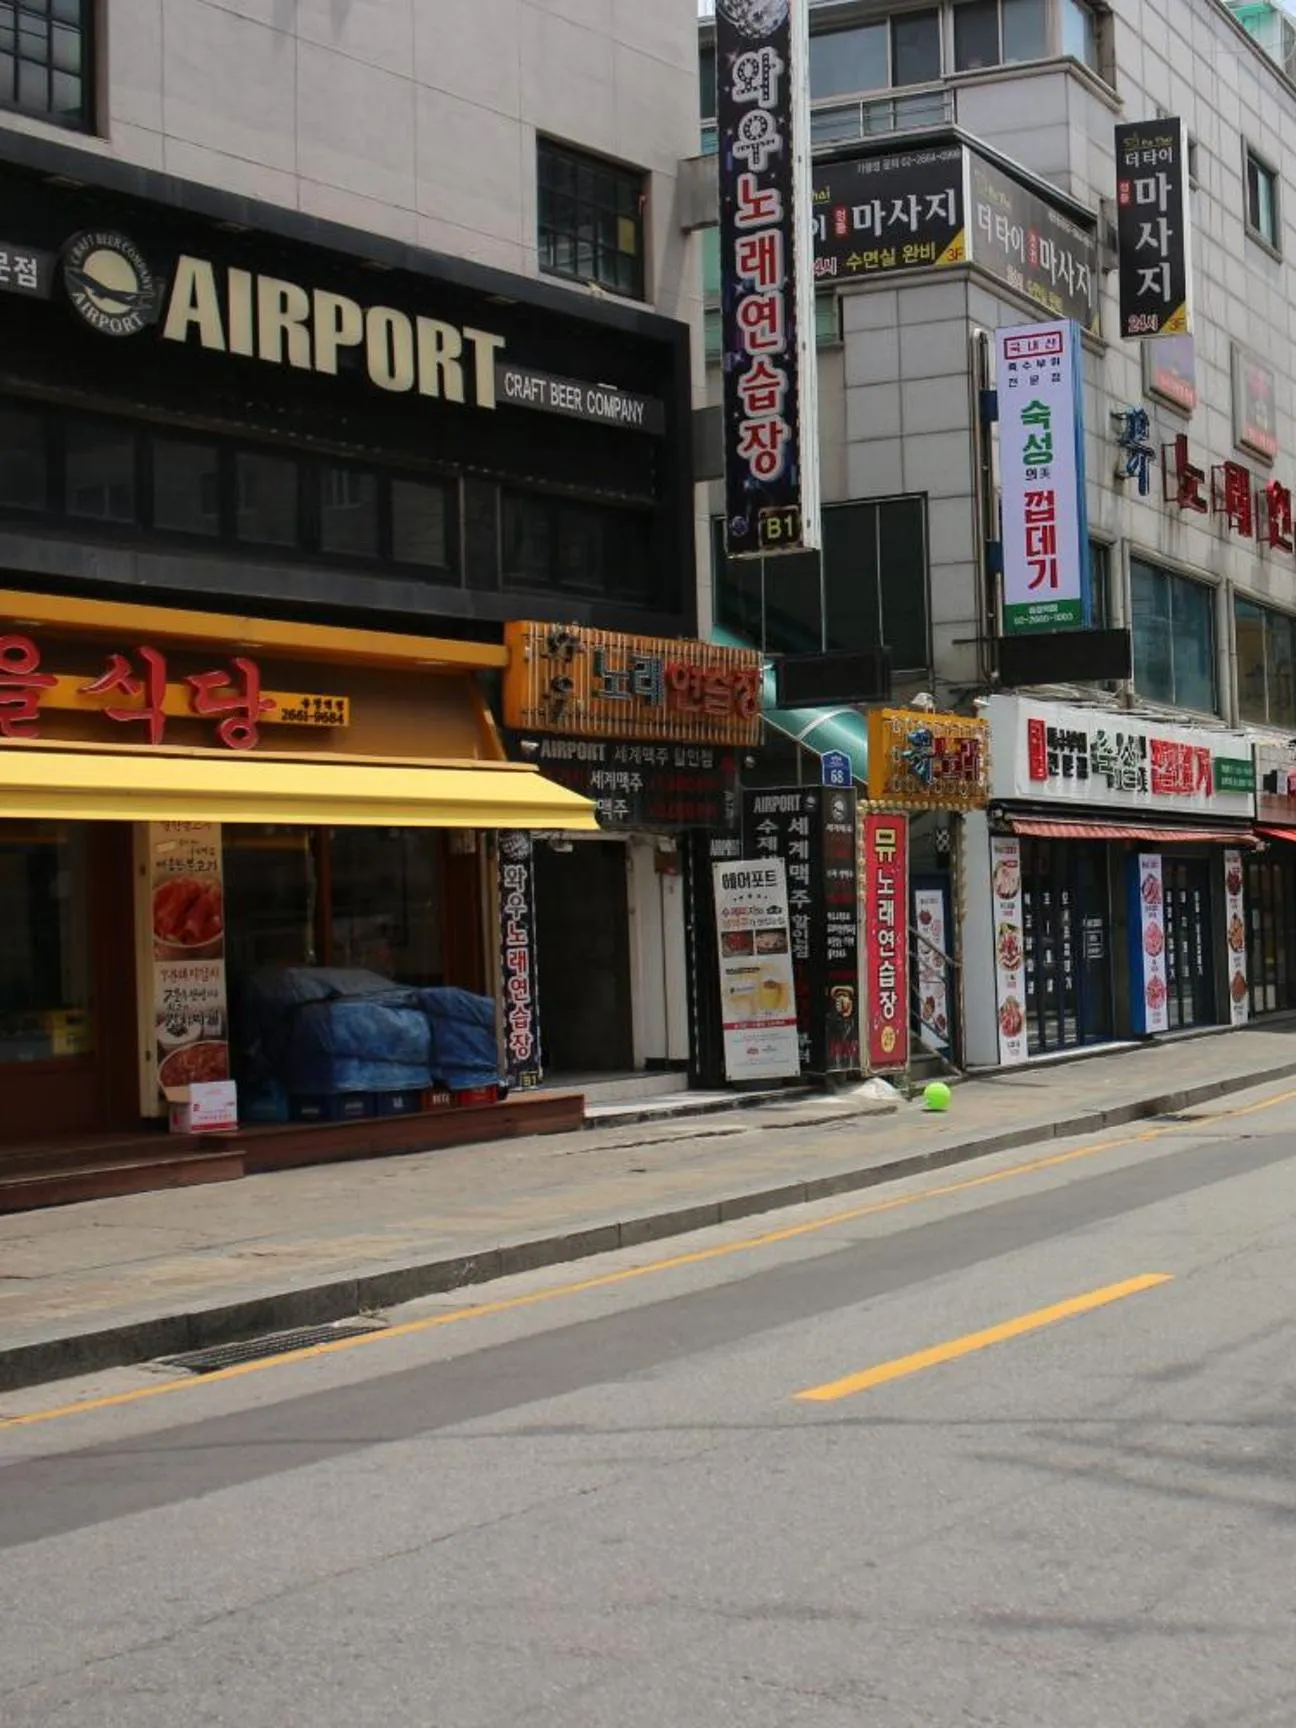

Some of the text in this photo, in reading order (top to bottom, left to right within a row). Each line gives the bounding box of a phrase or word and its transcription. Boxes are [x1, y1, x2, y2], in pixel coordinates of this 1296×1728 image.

[852, 188, 956, 237] 마사지
[1134, 171, 1173, 302] 마사지
[846, 247, 896, 271] 수면실
[902, 242, 936, 264] 완비
[1039, 237, 1092, 308] 마사지
[72, 292, 144, 333] AIRPORT
[163, 254, 505, 409] AIRPORT
[504, 371, 645, 425] CRAFT BEER COMPANY
[1020, 400, 1054, 465] 숙성
[766, 517, 793, 538] B1
[1024, 490, 1058, 589] 껍데기
[540, 741, 606, 762] AIRPORT
[590, 770, 644, 794] 세계맥주
[753, 794, 800, 813] AIRPORT
[788, 816, 811, 909] 세계맥주
